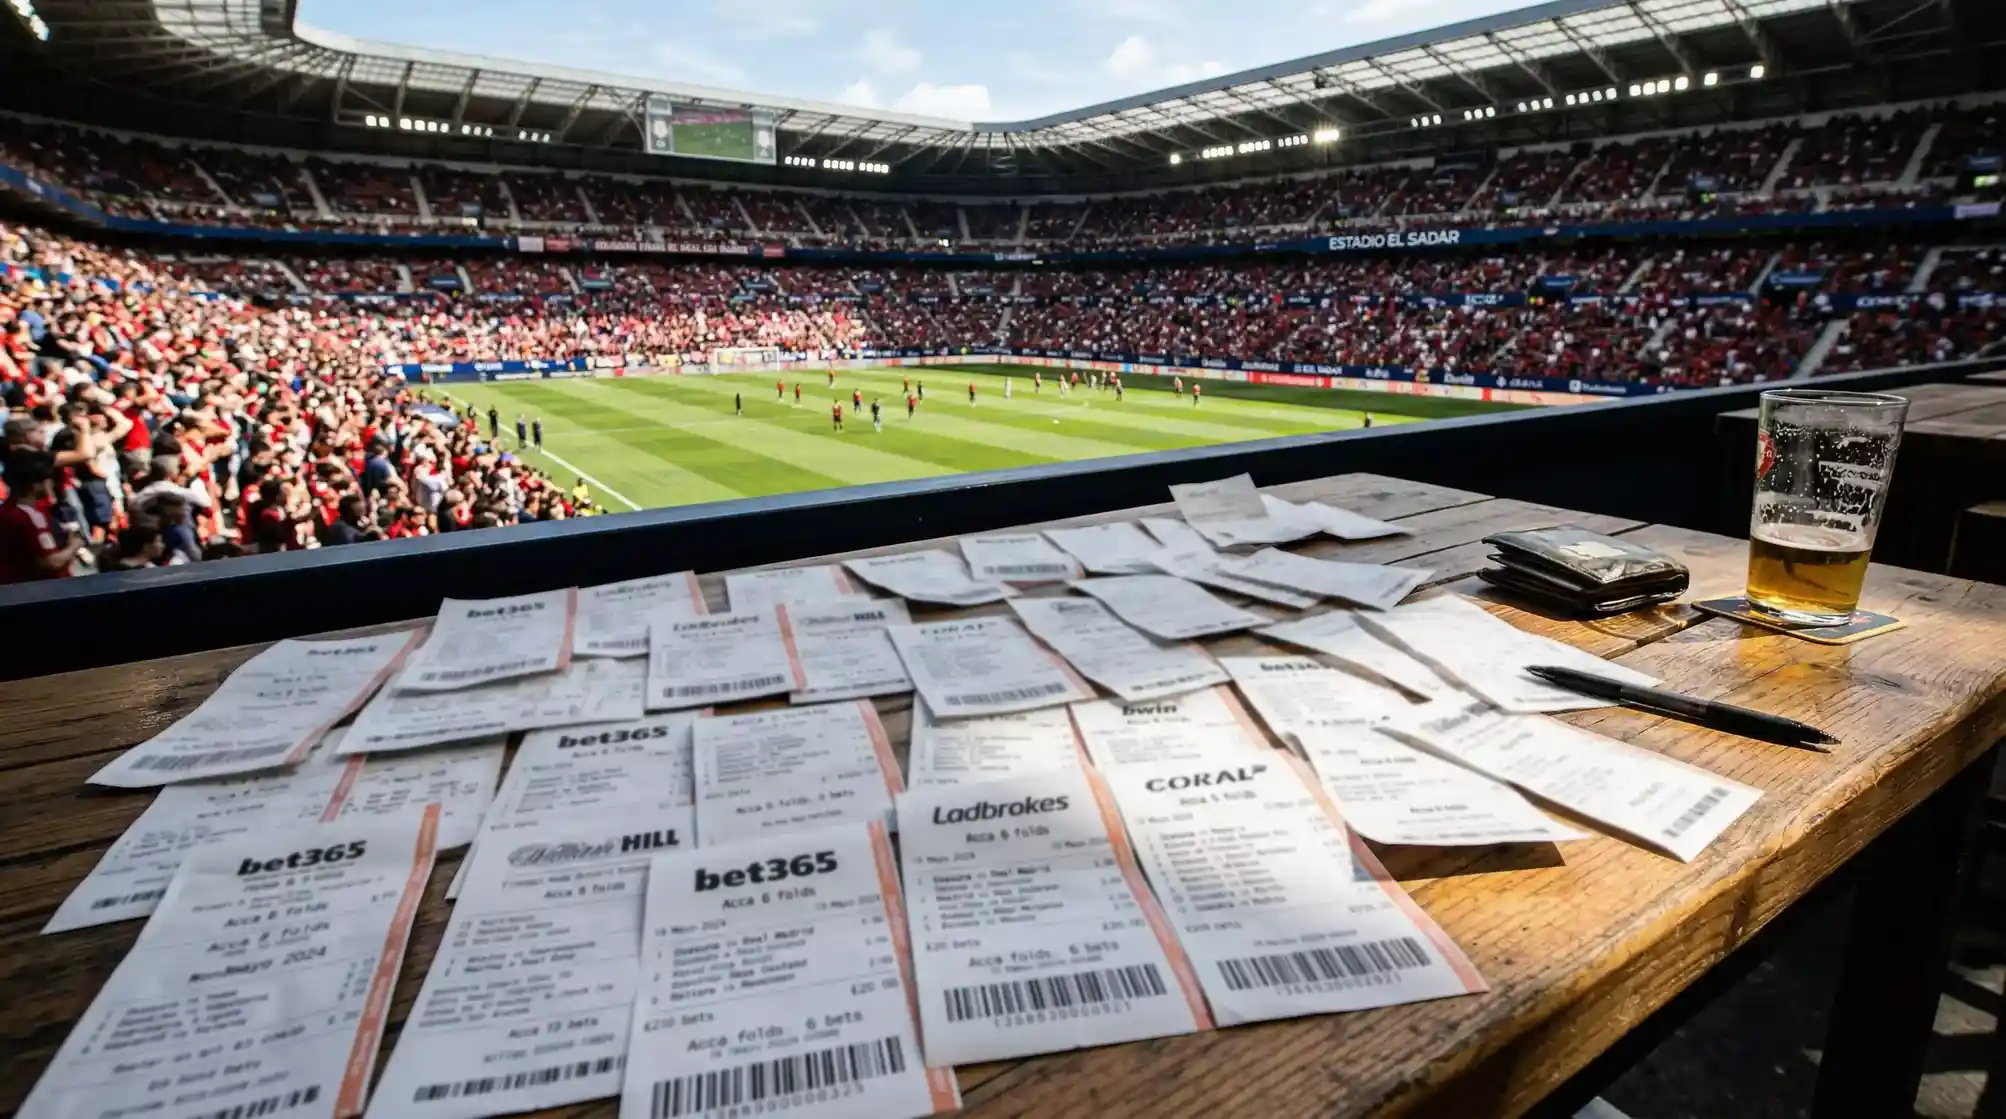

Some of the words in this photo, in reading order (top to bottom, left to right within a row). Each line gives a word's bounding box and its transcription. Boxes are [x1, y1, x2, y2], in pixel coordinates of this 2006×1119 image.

[1329, 235, 1385, 250] ESTADIO
[1387, 233, 1404, 247] EL
[1407, 230, 1460, 246] SADAR
[1122, 703, 1177, 716] bwin
[558, 726, 669, 749] bet365
[1145, 767, 1254, 792] CORAL
[932, 794, 1070, 826] Ladbrokes
[622, 829, 680, 852] HILL
[237, 840, 367, 876] bet365
[694, 850, 838, 892] bet365
[722, 896, 755, 910] Acca
[777, 887, 816, 901] folds
[968, 955, 1003, 968] Acca
[681, 1012, 715, 1026] bets
[687, 1036, 728, 1053] Acca
[825, 1010, 864, 1027] bets
